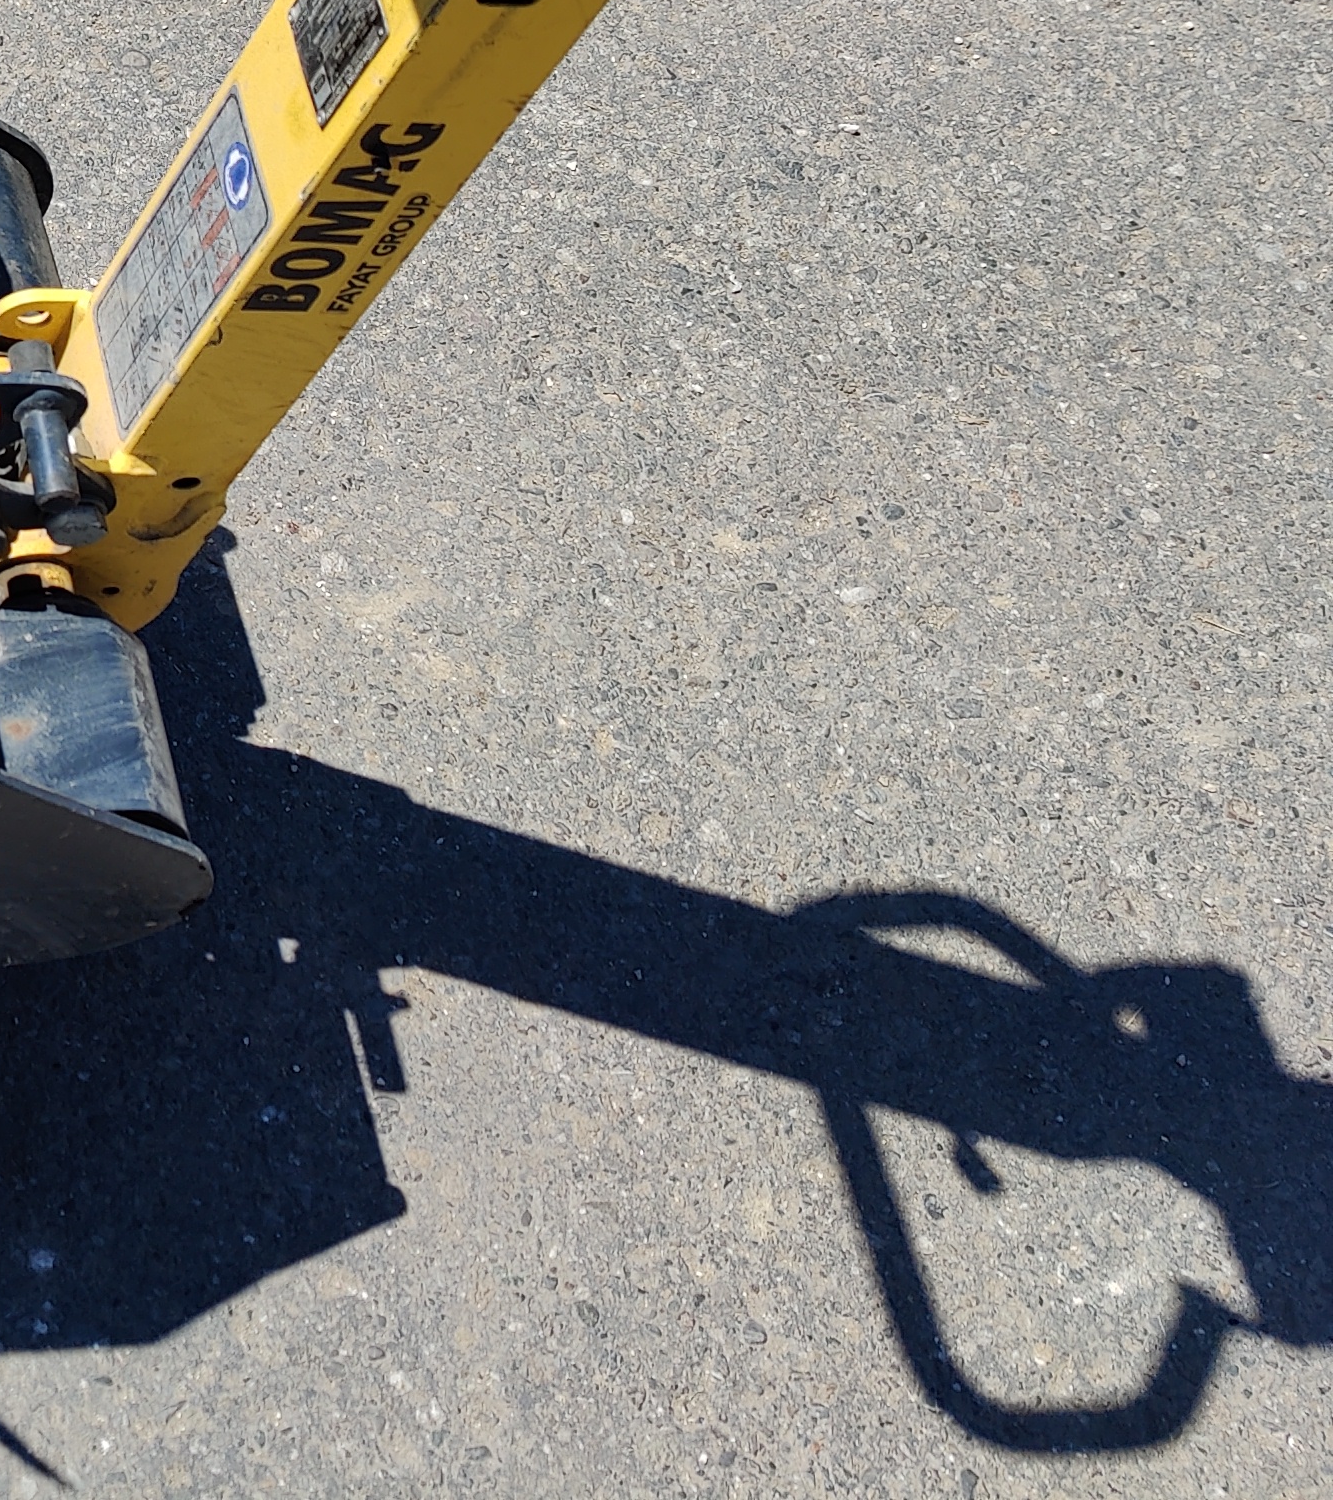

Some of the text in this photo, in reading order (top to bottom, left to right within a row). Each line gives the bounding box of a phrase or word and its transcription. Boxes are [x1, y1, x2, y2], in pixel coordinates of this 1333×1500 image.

[240, 122, 447, 312] BOMAG
[326, 193, 433, 313] FAYAT GROUP
